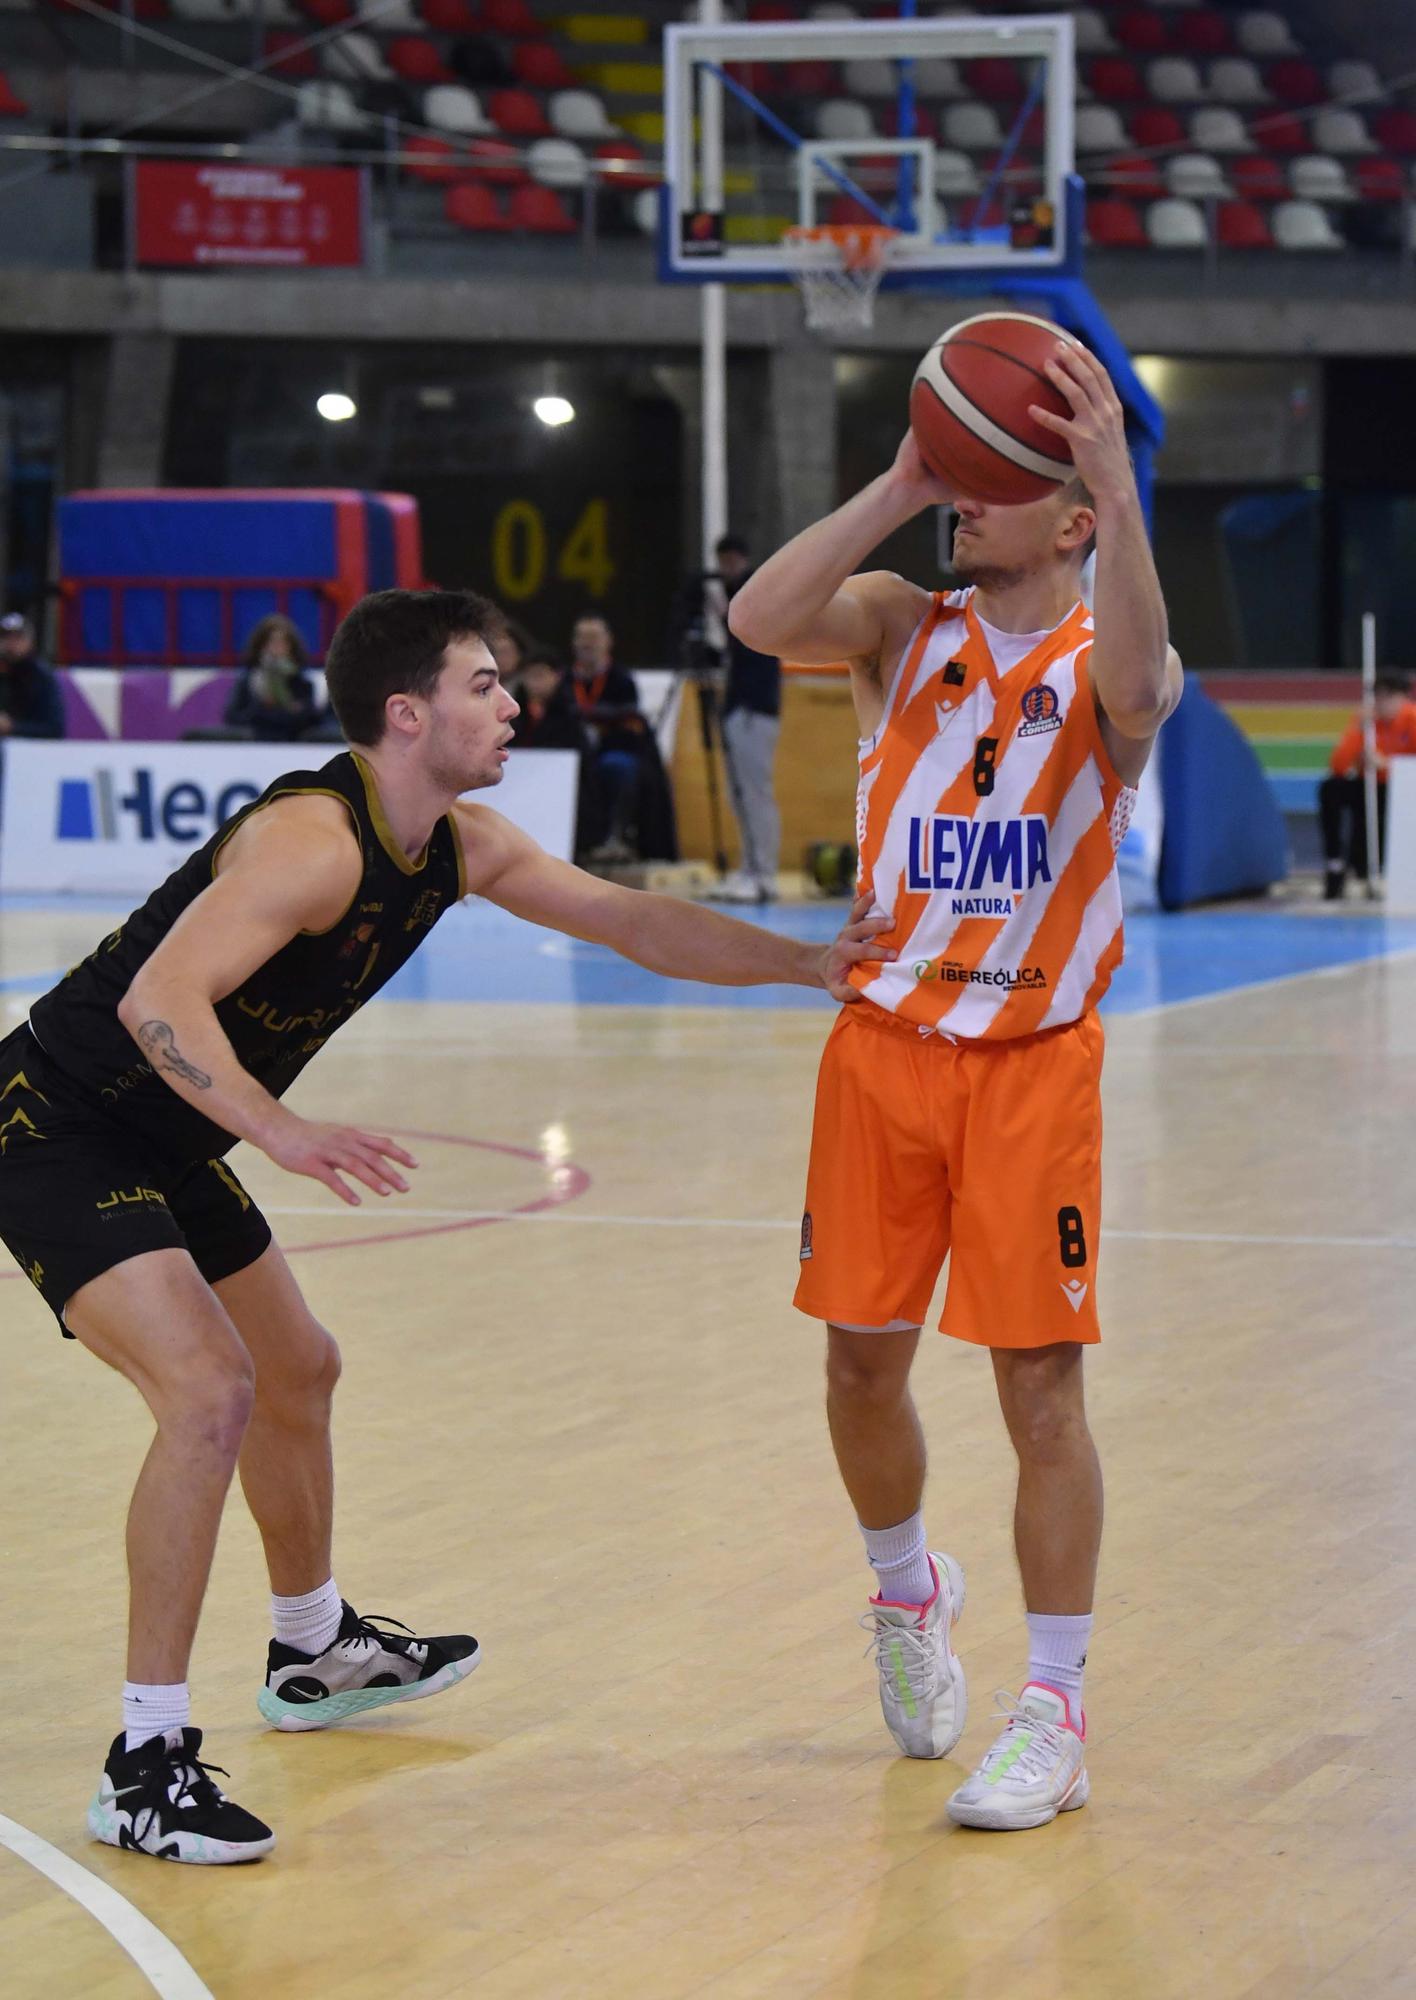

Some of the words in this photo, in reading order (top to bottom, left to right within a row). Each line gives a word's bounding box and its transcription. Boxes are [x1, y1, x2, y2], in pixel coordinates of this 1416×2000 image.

[495, 500, 615, 599] 04
[908, 816, 1053, 890] LEYMA
[951, 898, 1012, 915] NATURA
[940, 967, 1046, 986] IBEREÓLICA
[1057, 1205, 1088, 1269] 8
